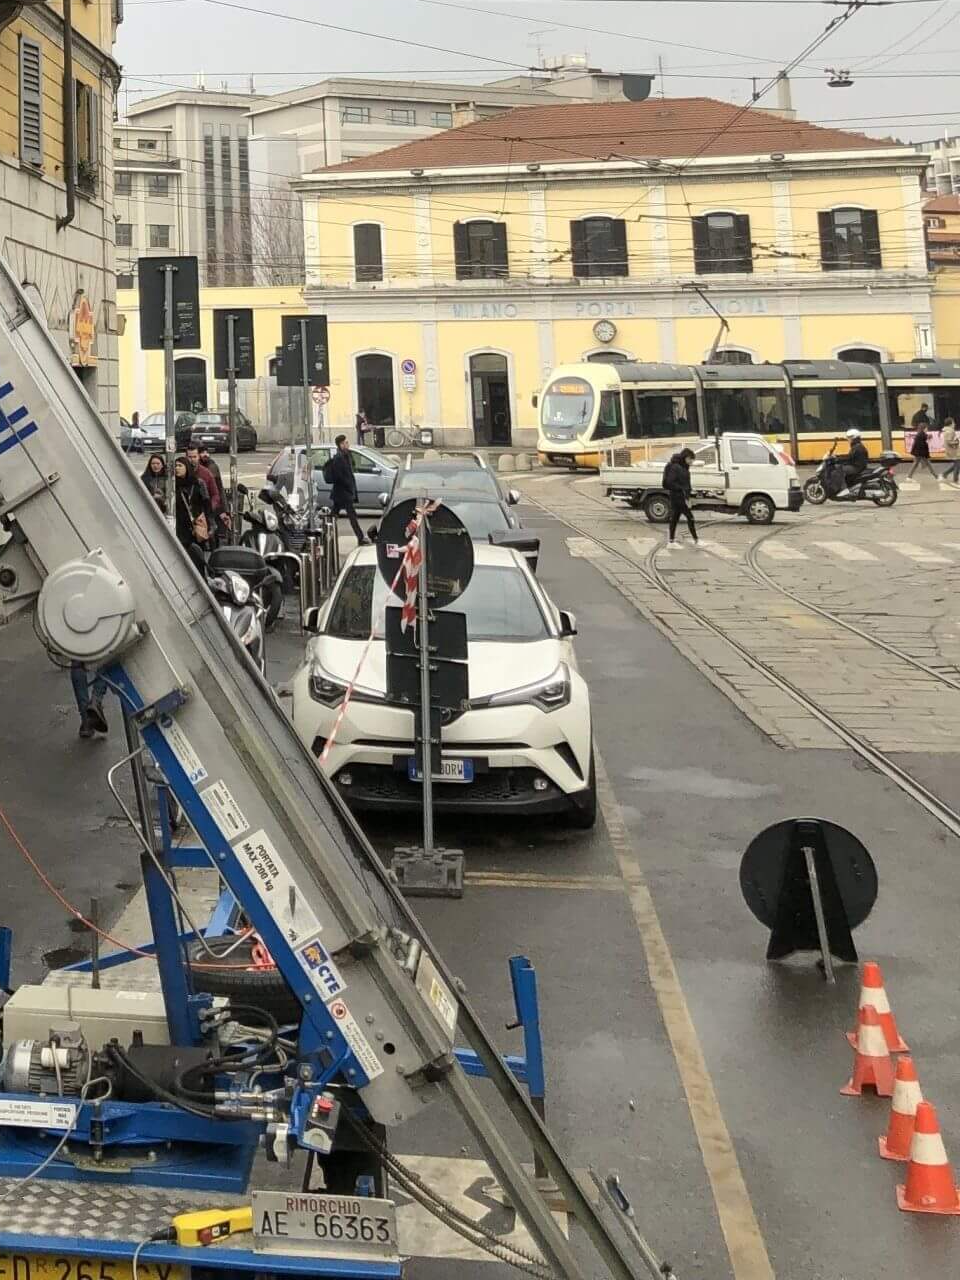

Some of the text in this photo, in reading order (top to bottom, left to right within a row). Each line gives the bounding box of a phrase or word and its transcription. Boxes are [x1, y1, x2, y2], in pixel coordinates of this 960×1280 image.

[452, 303, 519, 319] MILANO
[575, 302, 638, 317] PORTA
[242, 843, 257, 863] MAX
[254, 863, 268, 880] 200
[256, 844, 280, 879] PORTATA
[318, 965, 341, 994] CTE
[286, 1197, 361, 1215] RIMORCHIO
[261, 1210, 390, 1242] AE 66363
